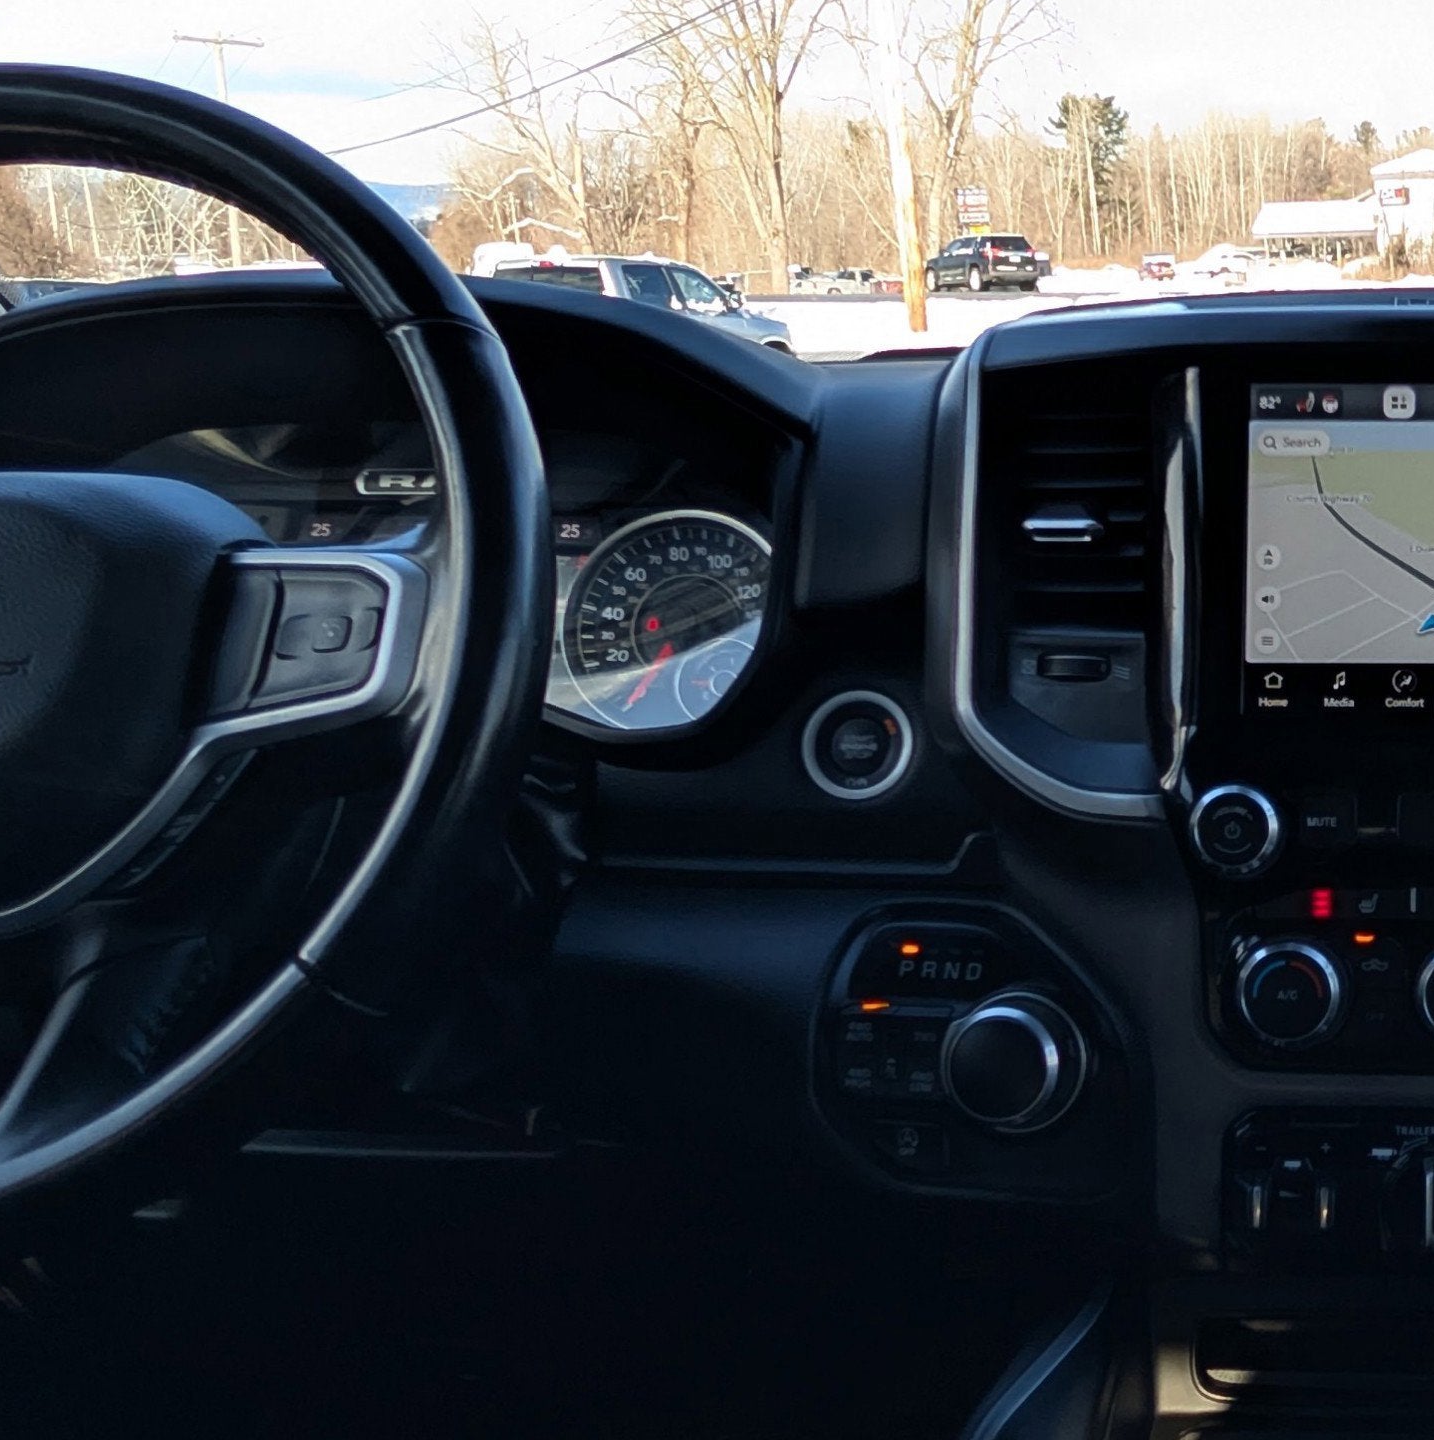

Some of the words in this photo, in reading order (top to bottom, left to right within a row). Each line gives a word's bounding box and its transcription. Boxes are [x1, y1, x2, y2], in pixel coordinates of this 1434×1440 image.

[1283, 436, 1321, 448] Search
[310, 523, 332, 538] 25
[560, 523, 581, 539] 25
[648, 555, 663, 565] 70
[669, 547, 689, 562] 80
[706, 554, 733, 569] 100
[624, 568, 647, 582] 60
[737, 583, 761, 599] 120
[602, 607, 625, 621] 40
[606, 649, 629, 663] 20
[1258, 697, 1289, 708] Home
[1323, 696, 1355, 708] Media
[1385, 696, 1425, 708] Comfort
[1306, 816, 1338, 828] MUTE
[898, 960, 915, 978] P
[921, 960, 937, 979] R
[943, 961, 961, 980] N
[965, 962, 983, 981] D
[1277, 990, 1298, 1000] A/C
